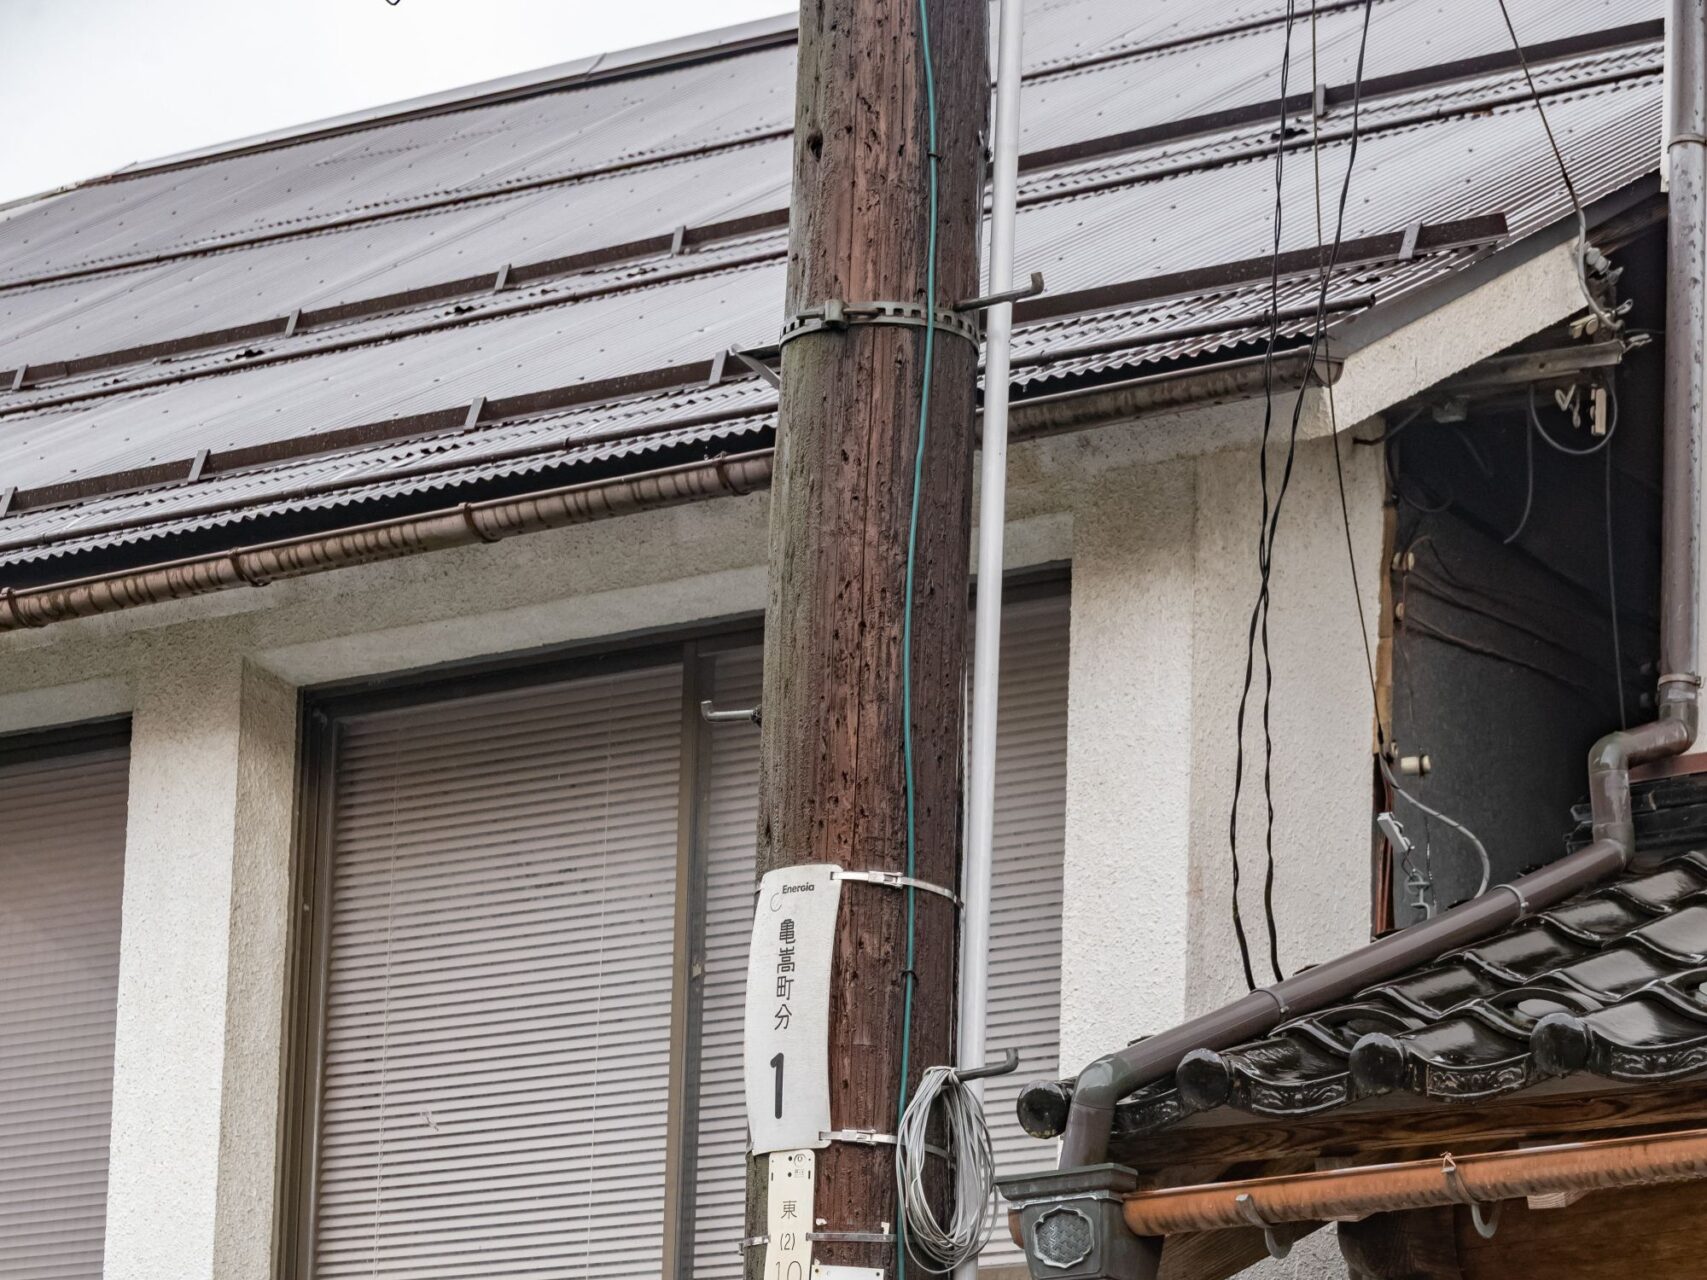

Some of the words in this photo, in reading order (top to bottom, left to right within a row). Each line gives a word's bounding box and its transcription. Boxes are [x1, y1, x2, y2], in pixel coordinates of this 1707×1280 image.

[774, 918, 797, 1031] 亀嵩町分
[769, 1052, 785, 1120] 1
[781, 1200, 798, 1220] 東
[780, 1232, 796, 1251] (2)
